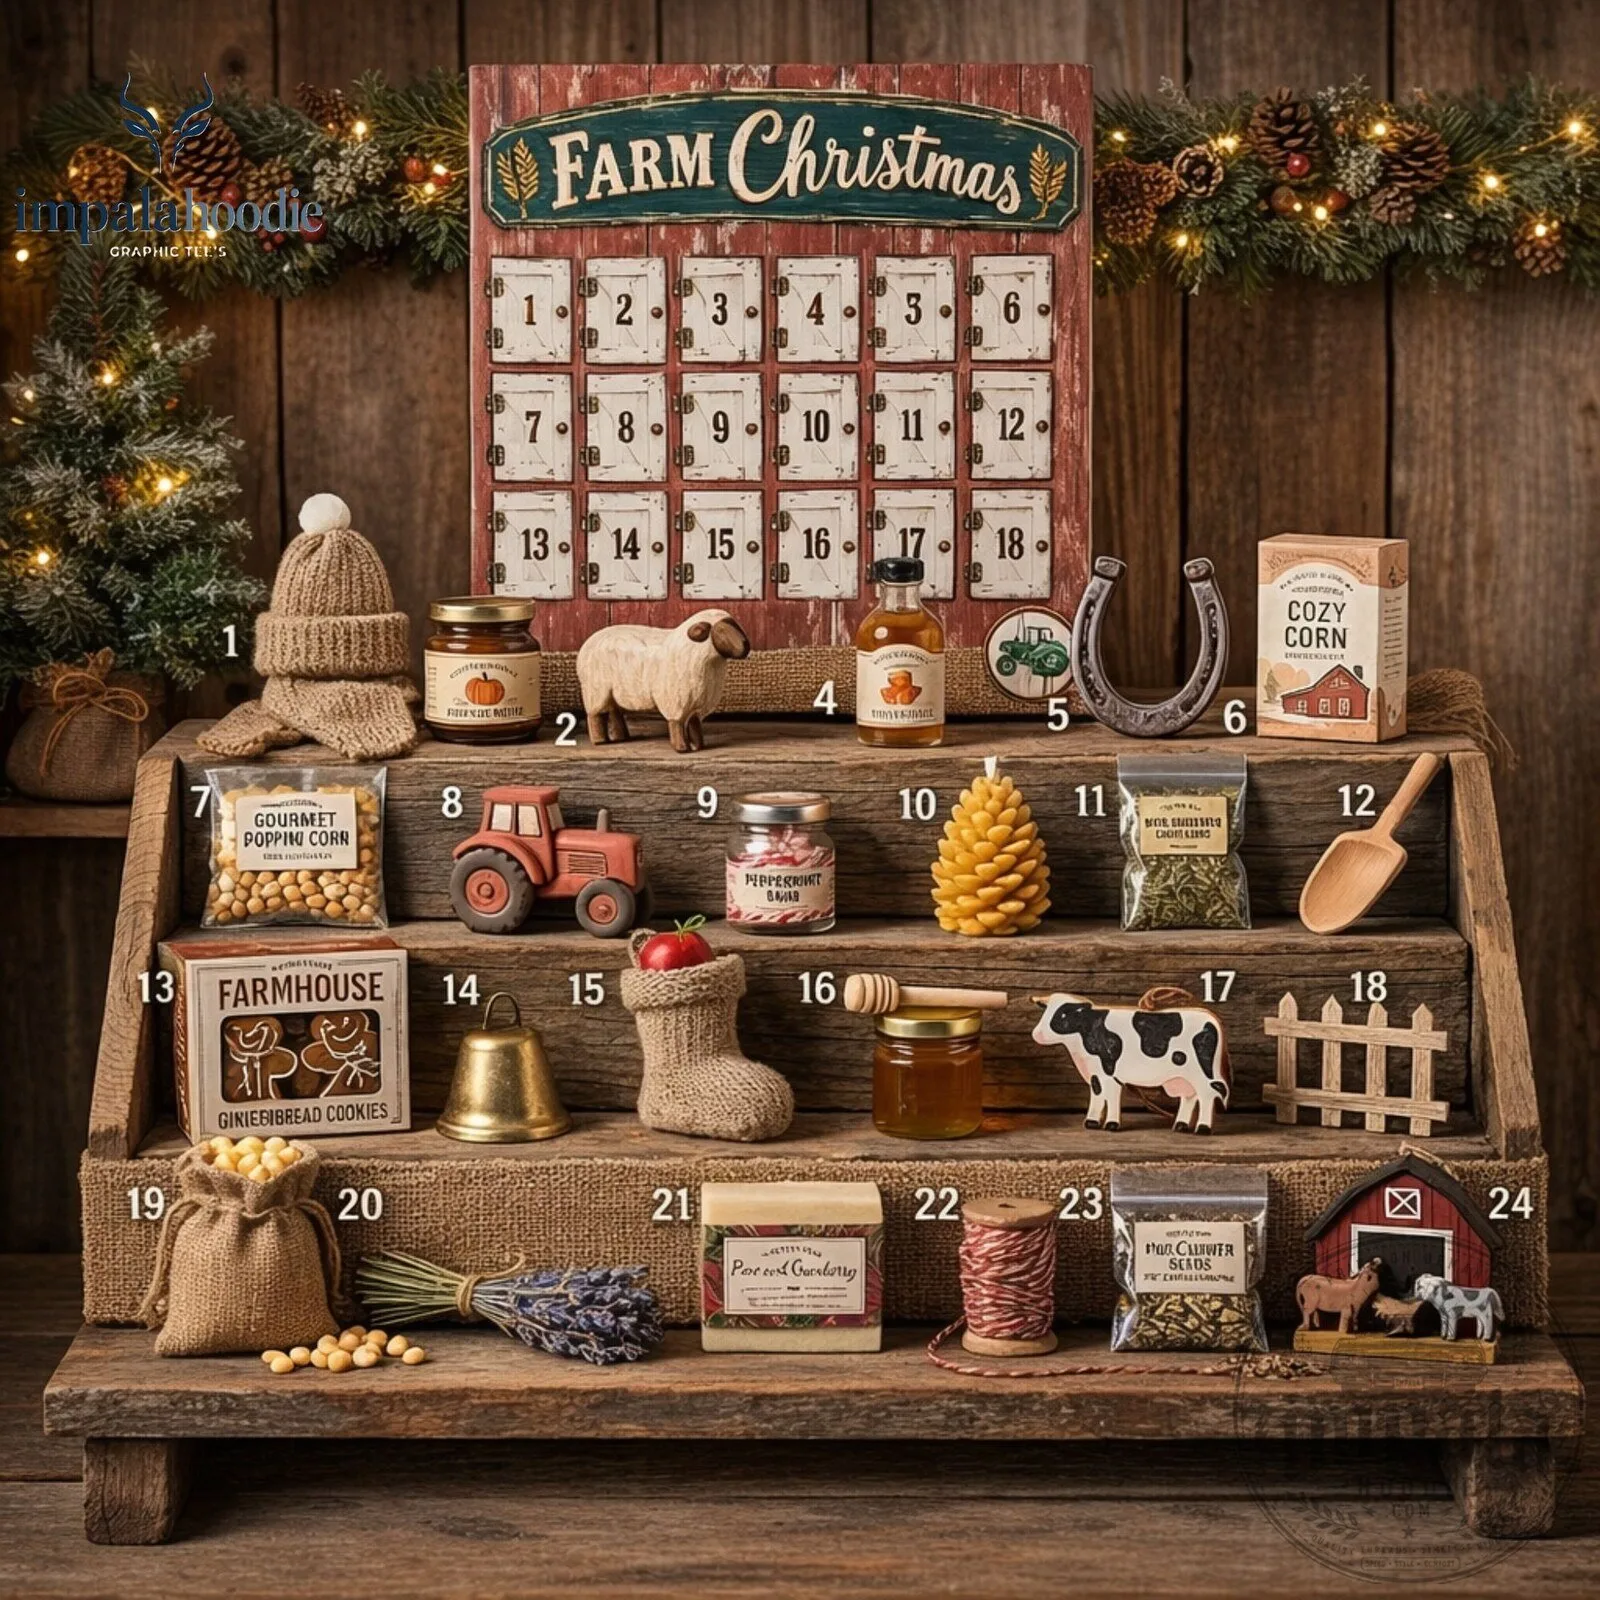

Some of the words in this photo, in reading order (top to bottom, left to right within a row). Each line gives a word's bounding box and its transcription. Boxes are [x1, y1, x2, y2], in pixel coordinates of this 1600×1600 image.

[727, 108, 1021, 214] Christmas
[524, 294, 536, 326] 1
[615, 293, 633, 326] 2
[711, 292, 728, 326] 3
[806, 292, 825, 326] 4
[1003, 291, 1021, 324] 6
[525, 410, 542, 443] 7
[618, 410, 635, 444] 8
[712, 410, 729, 444] 9
[803, 409, 830, 443] 10
[901, 408, 924, 442] 11
[998, 407, 1025, 441] 12
[521, 527, 549, 561] 13
[613, 527, 641, 560] 14
[707, 527, 735, 561] 15
[803, 527, 831, 560] 16
[899, 527, 926, 558] 17
[997, 527, 1025, 561] 18
[1287, 599, 1347, 623] COZY
[1284, 626, 1347, 649] CORN
[218, 972, 385, 1010] FARMHOUSE
[326, 1102, 389, 1122] COOKIES
